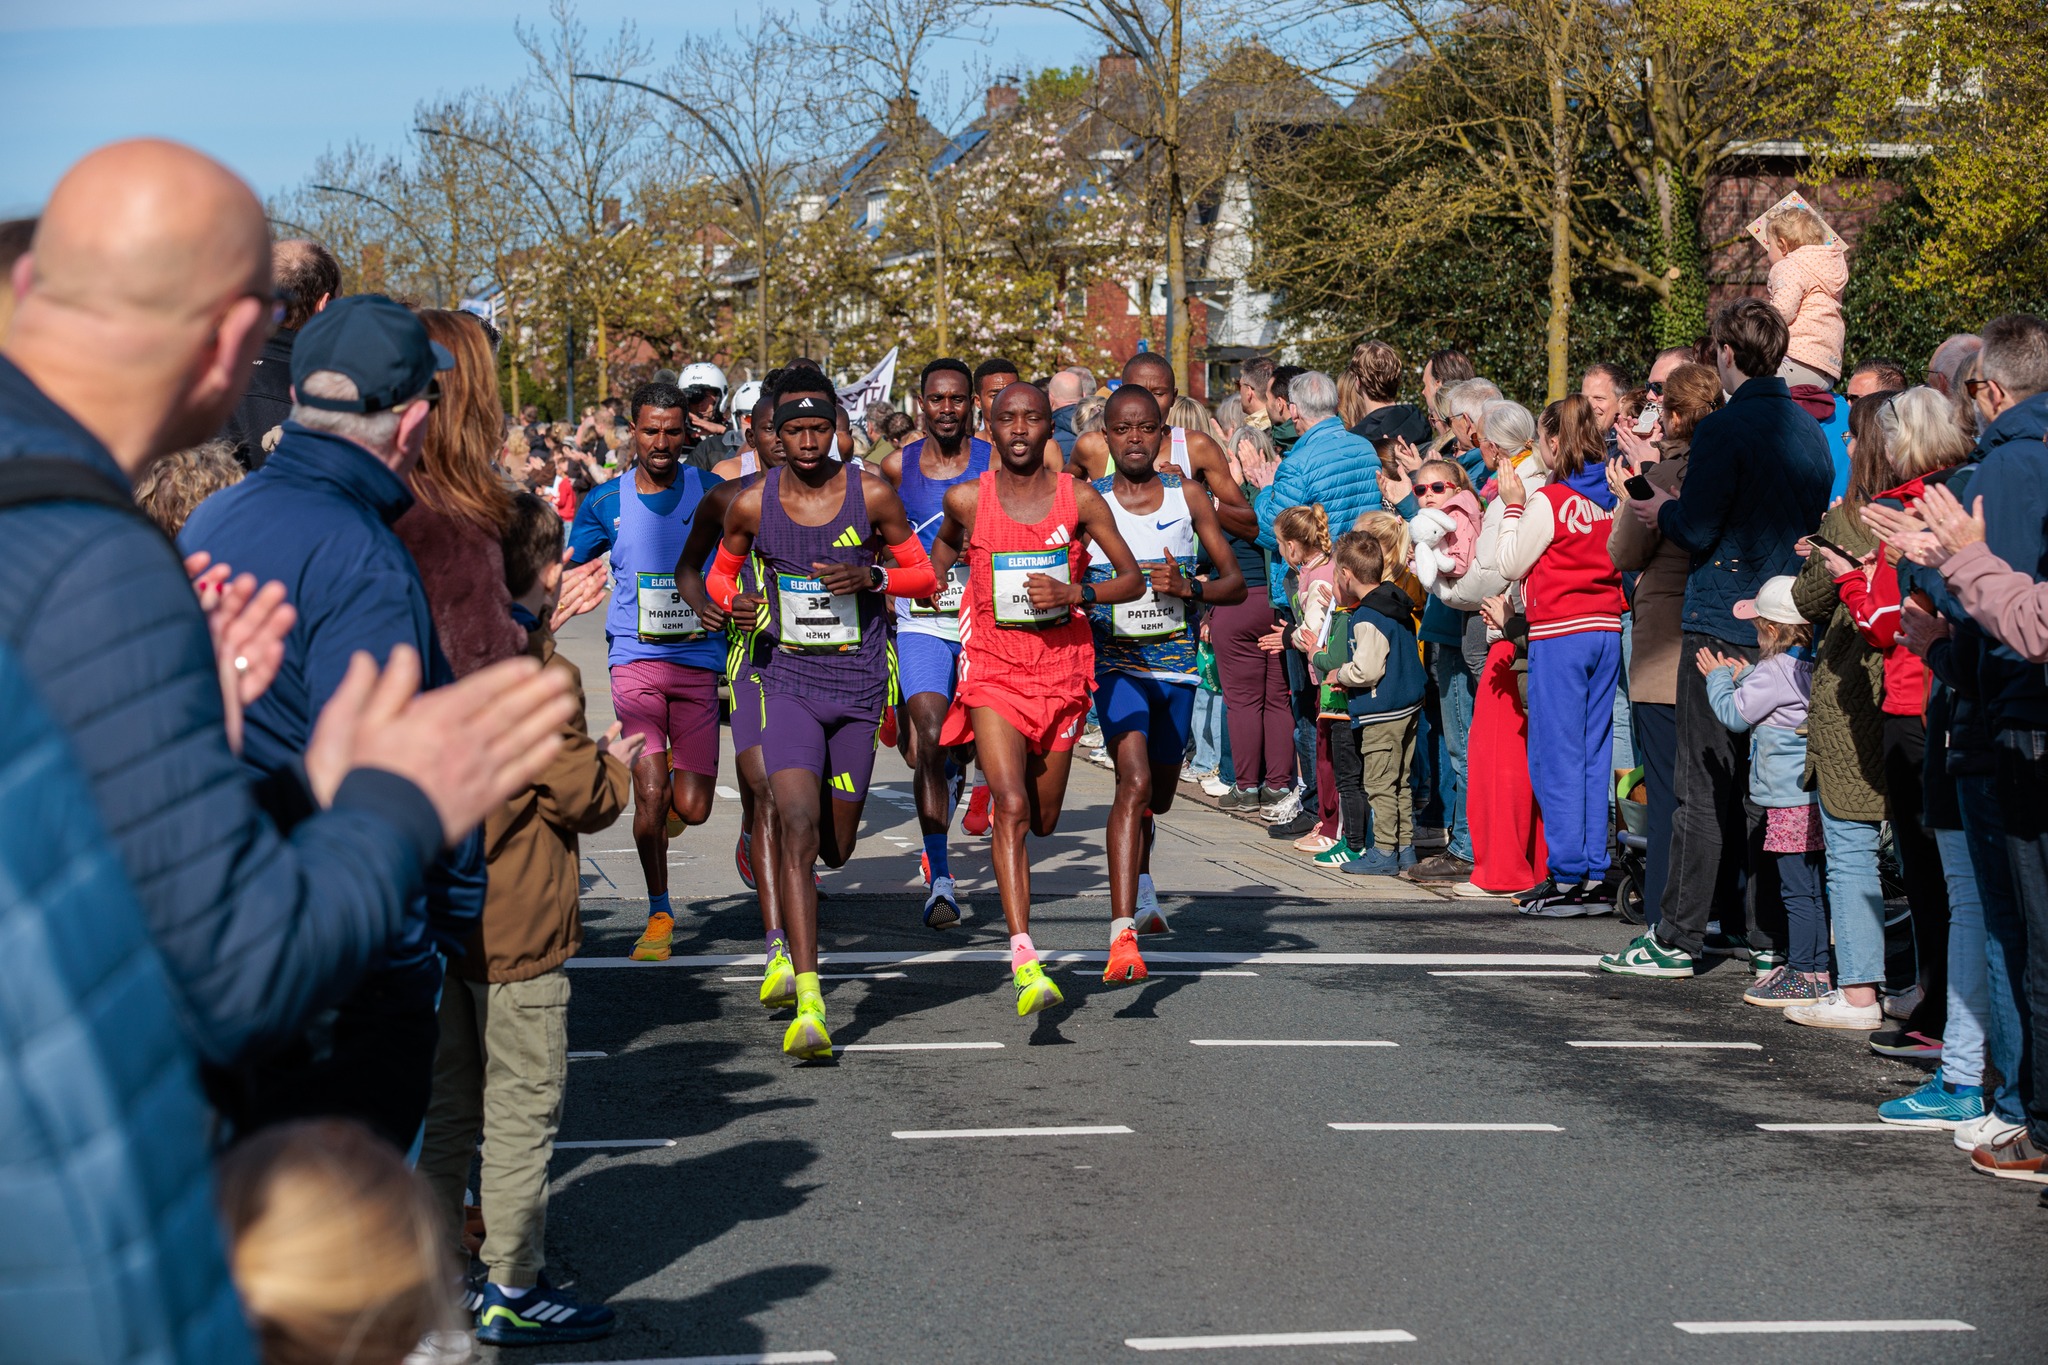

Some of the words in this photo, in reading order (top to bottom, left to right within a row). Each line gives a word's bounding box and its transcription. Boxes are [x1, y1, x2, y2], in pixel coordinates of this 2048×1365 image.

[1008, 555, 1056, 567] ELEKTRAMAT
[651, 578, 676, 587] ELEKTR
[671, 592, 680, 604] 9
[1151, 591, 1160, 603] 1
[807, 597, 831, 610] 32
[1024, 608, 1048, 616] 42KM
[1128, 606, 1174, 619] PATRICK
